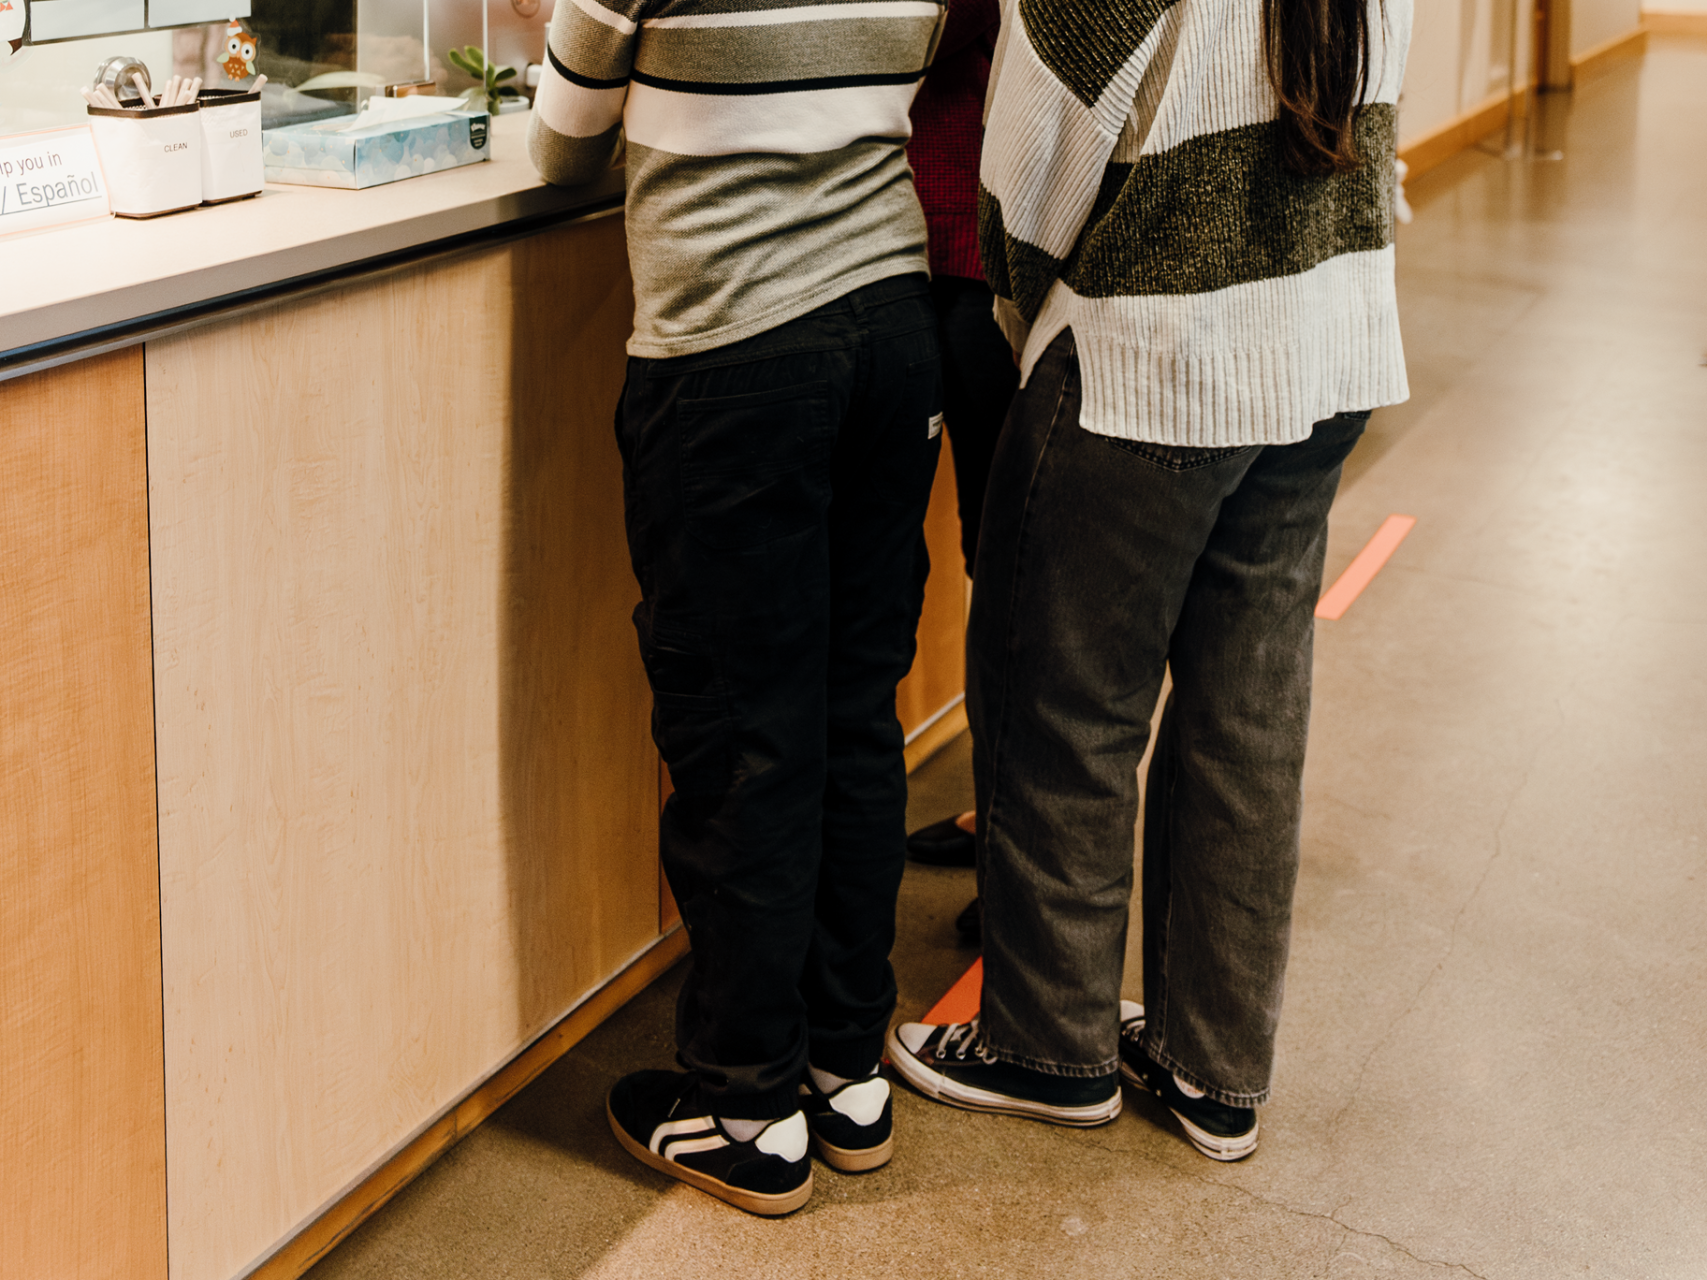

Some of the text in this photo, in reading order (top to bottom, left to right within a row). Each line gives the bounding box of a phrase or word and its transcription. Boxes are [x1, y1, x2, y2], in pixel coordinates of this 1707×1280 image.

[229, 128, 249, 139] USED
[163, 141, 188, 153] CLEAN
[16, 157, 44, 176] you
[47, 151, 62, 167] in
[16, 170, 99, 208] Español
